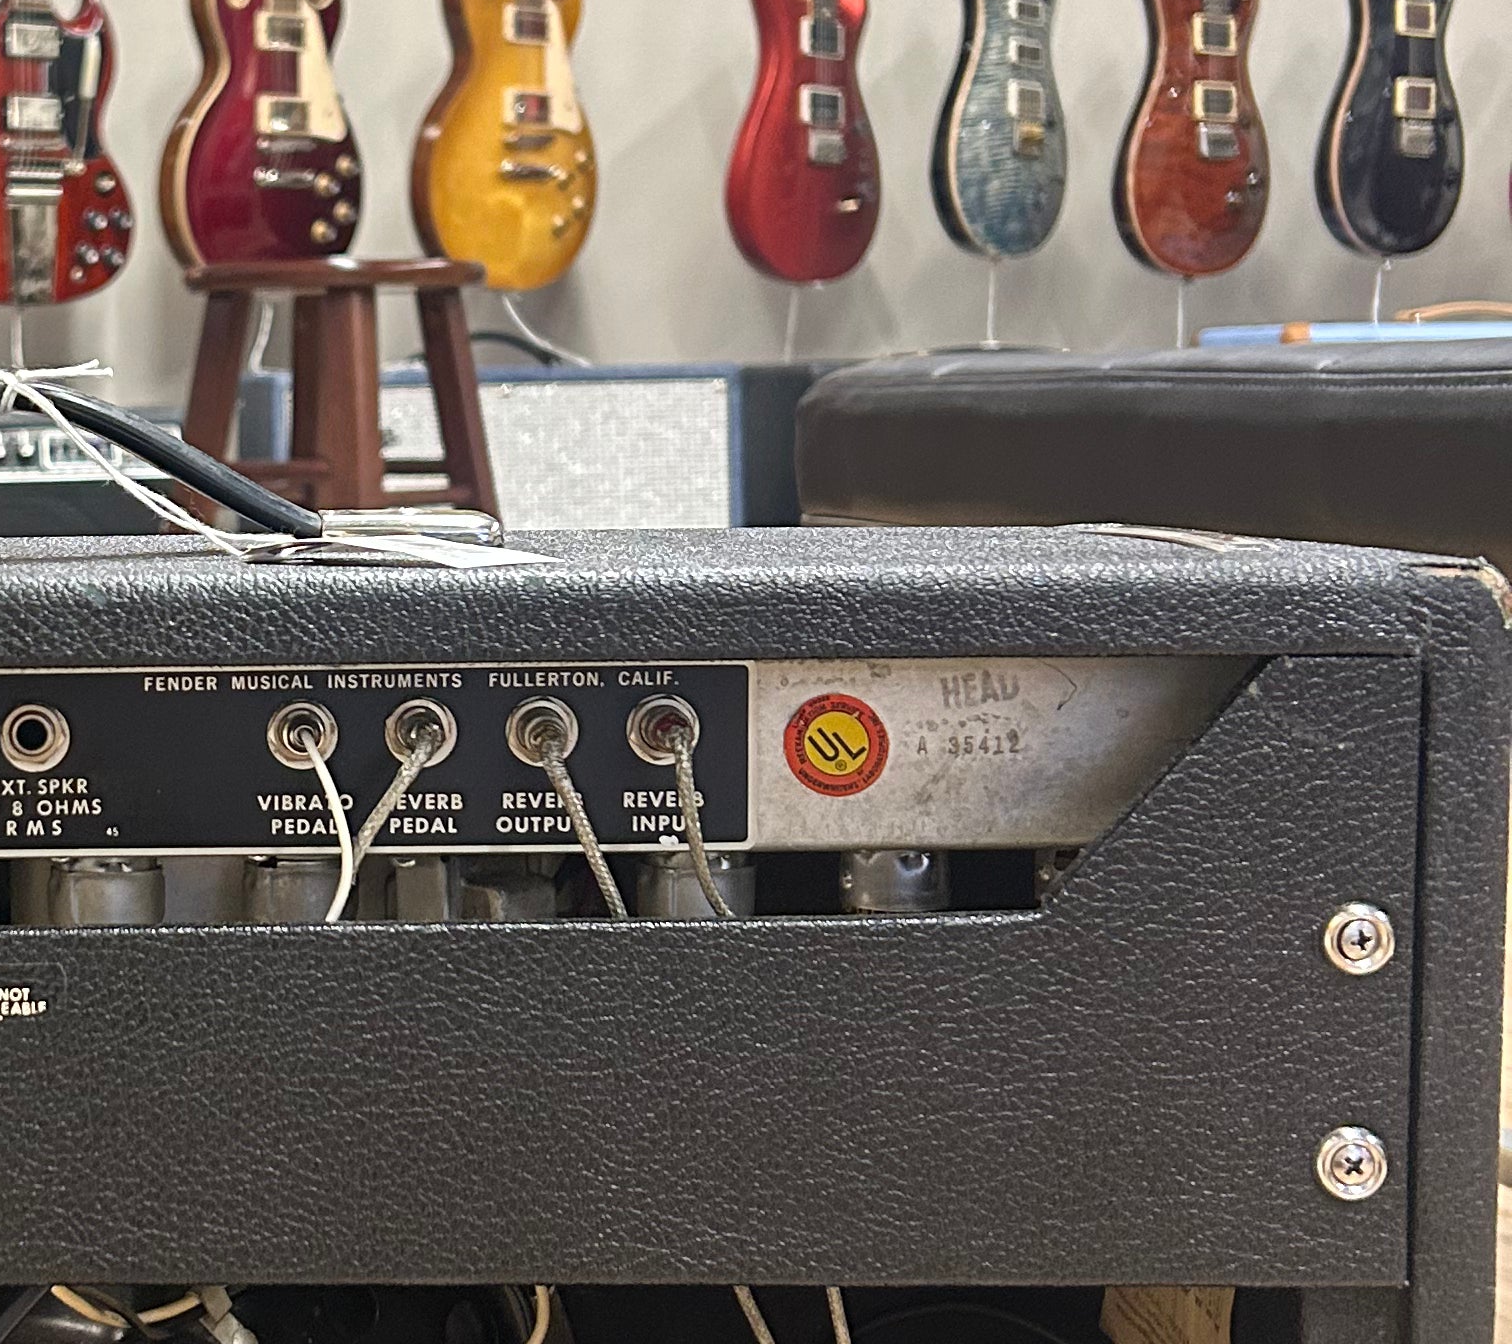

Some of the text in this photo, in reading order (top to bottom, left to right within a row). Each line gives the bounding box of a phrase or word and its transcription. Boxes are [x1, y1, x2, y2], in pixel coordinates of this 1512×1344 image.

[144, 676, 218, 692] FENDER
[231, 674, 313, 690] MUSICAL
[327, 672, 462, 689] INSTRUMENTS
[618, 670, 679, 686] CALIF.
[940, 670, 1020, 709] HEAD
[807, 727, 867, 762] UL
[916, 736, 928, 755] A
[38, 778, 89, 795] SPKR
[11, 800, 24, 817] 8
[36, 798, 103, 816] OHMS
[257, 794, 354, 811] VIBRAO
[396, 793, 464, 811] EVERB
[622, 791, 705, 809] REVEB
[106, 827, 120, 837] 45
[271, 818, 339, 835] PEDAL
[389, 817, 458, 834] PEDAL
[495, 816, 572, 833] OUTPU
[632, 815, 686, 832] INPU
